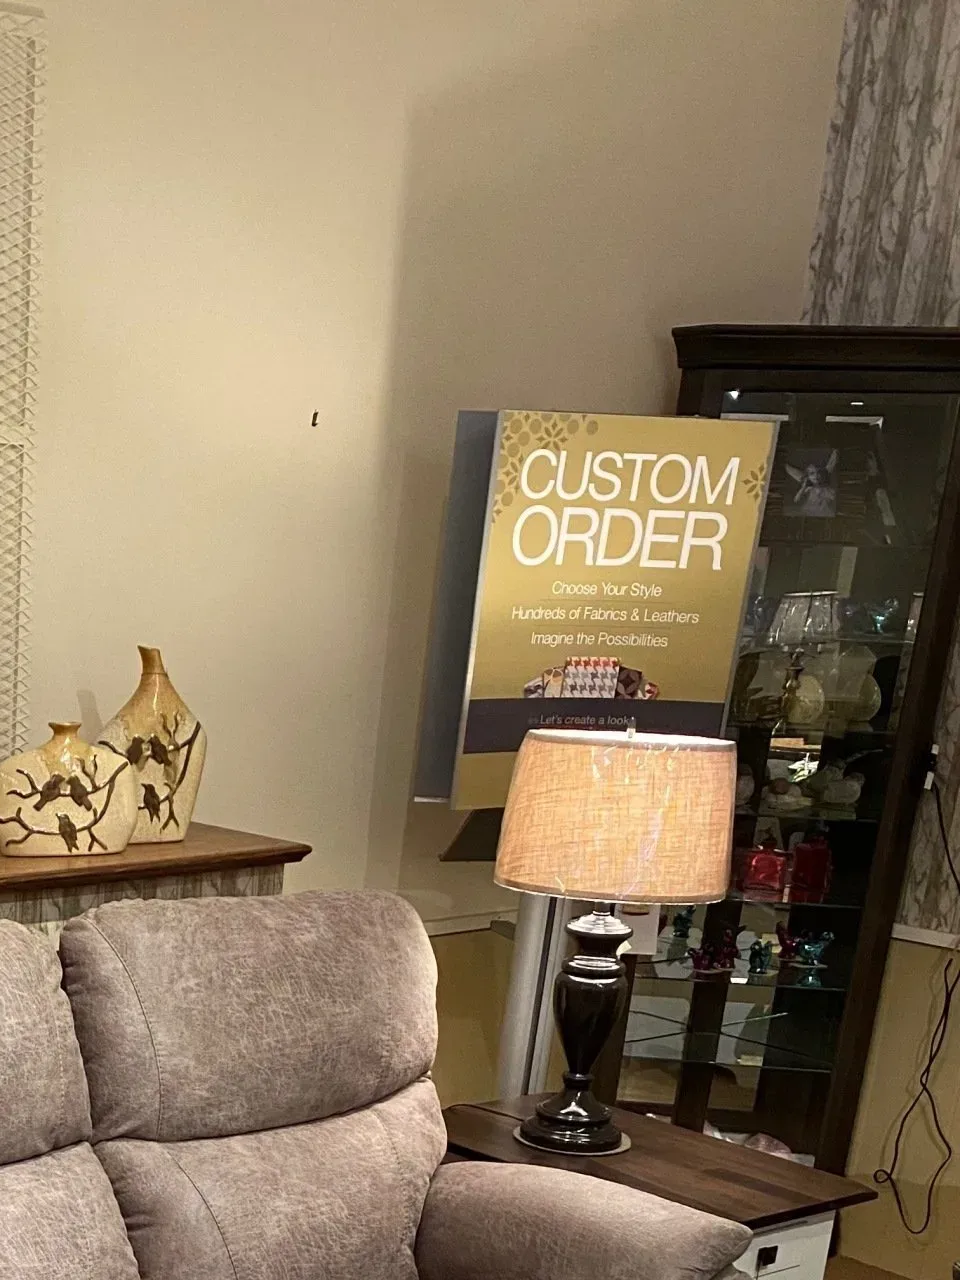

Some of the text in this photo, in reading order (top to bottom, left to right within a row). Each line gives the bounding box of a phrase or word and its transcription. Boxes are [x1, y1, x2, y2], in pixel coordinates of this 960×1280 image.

[520, 449, 740, 505] CUSTOM
[512, 504, 728, 571] ORDER
[551, 580, 662, 600] Choose Your Style
[511, 606, 700, 624] Hundreds of Fabrics & Leathers
[530, 631, 669, 648] Imagine the Possibilities
[540, 714, 562, 725] Let's
[564, 715, 596, 725] create
[598, 717, 605, 725] a
